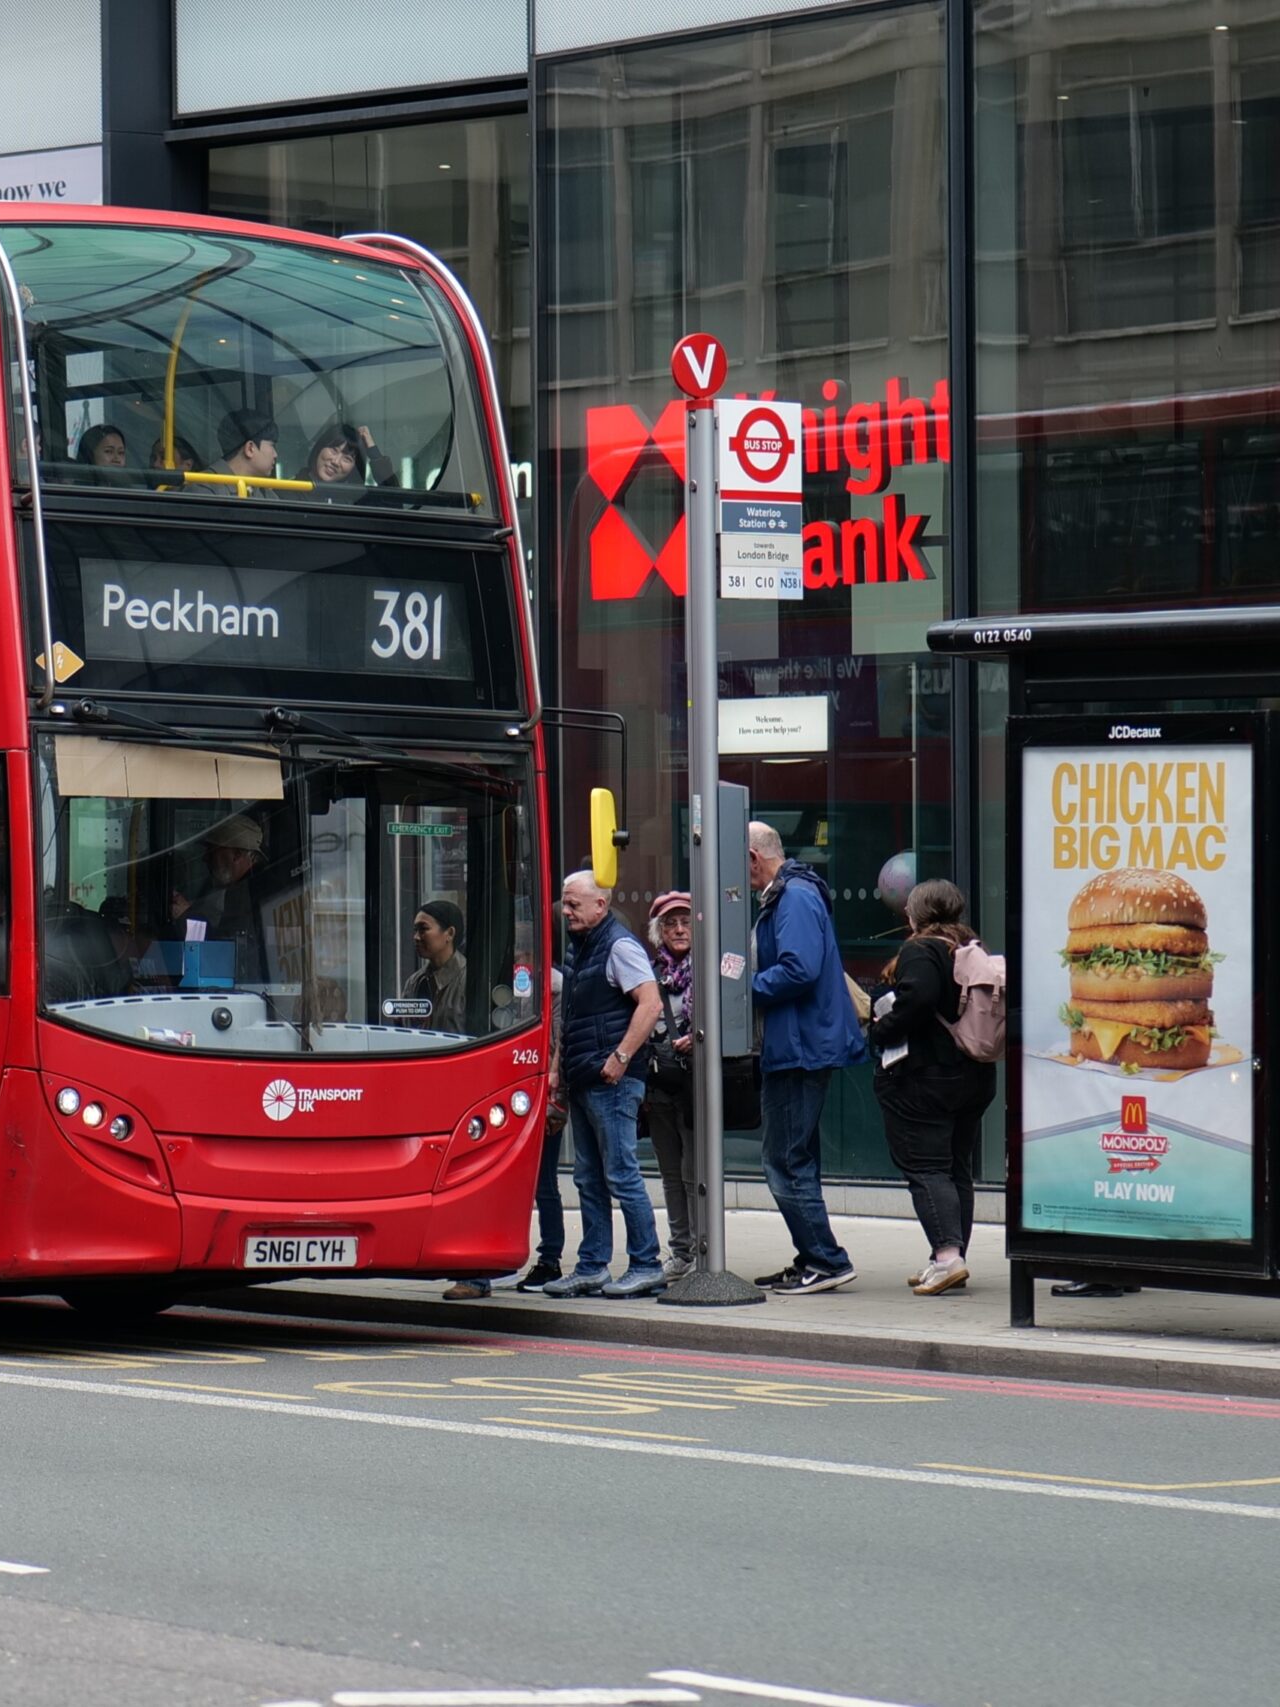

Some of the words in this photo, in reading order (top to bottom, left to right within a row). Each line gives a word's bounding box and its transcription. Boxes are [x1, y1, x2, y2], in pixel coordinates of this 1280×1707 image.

[38, 180, 67, 198] we
[682, 343, 717, 389] V
[743, 439, 761, 451] BUS
[761, 440, 783, 452] STOP
[746, 507, 782, 518] Waterloo
[739, 518, 767, 529] Station
[737, 550, 766, 560] London
[767, 551, 790, 562] Bridge
[728, 575, 746, 588] 381
[755, 576, 775, 588] C10
[780, 578, 801, 589] N381
[102, 584, 280, 638] Peckham
[370, 590, 443, 660] 381
[974, 630, 1000, 644] 0122
[1003, 628, 1032, 642] 0540
[1108, 725, 1161, 739] JCDecaux
[1051, 761, 1226, 825] CHICKEN
[392, 824, 432, 834] EMERGENCY
[433, 826, 449, 835] EXIT
[1053, 825, 1121, 871] BIG
[1127, 825, 1227, 871] MAC
[512, 1049, 538, 1064] 2426
[297, 1088, 363, 1101] TRANSPORT
[298, 1099, 315, 1113] UK
[1103, 1135, 1166, 1151] MONOPOLY
[1094, 1180, 1134, 1200] PLAY
[1136, 1183, 1175, 1203] NOW
[255, 1240, 300, 1263] SN61
[306, 1239, 346, 1262] CYH
